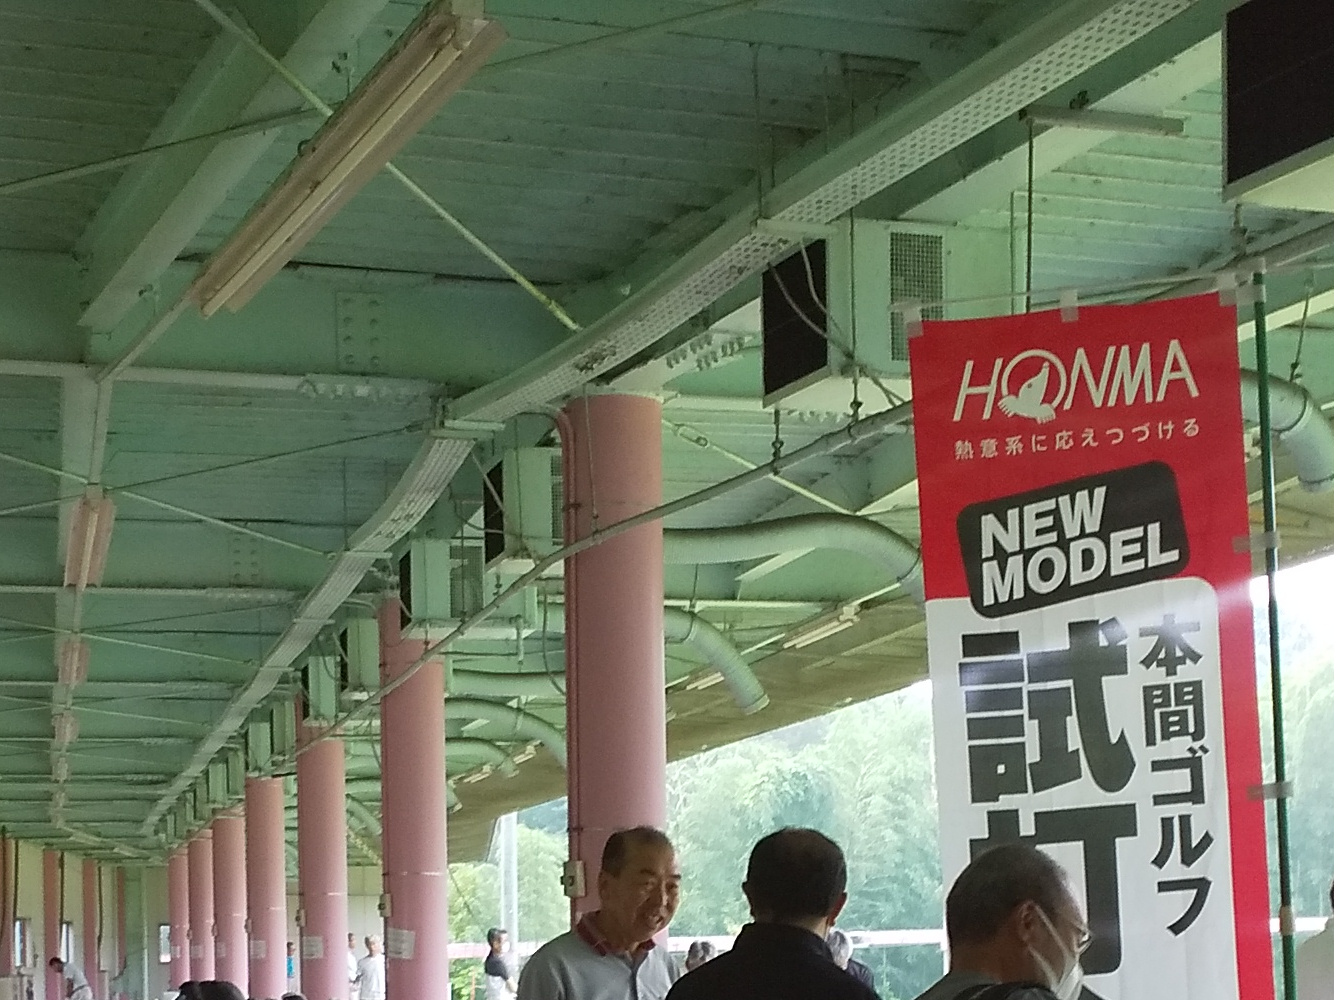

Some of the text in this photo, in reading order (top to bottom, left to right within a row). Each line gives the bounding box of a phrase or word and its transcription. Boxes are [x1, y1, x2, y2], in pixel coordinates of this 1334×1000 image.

[952, 339, 1199, 424] HONMA
[981, 486, 1106, 558] NEW
[982, 522, 1179, 607] MODEL
[1139, 613, 1214, 937] 本間ゴルフ
